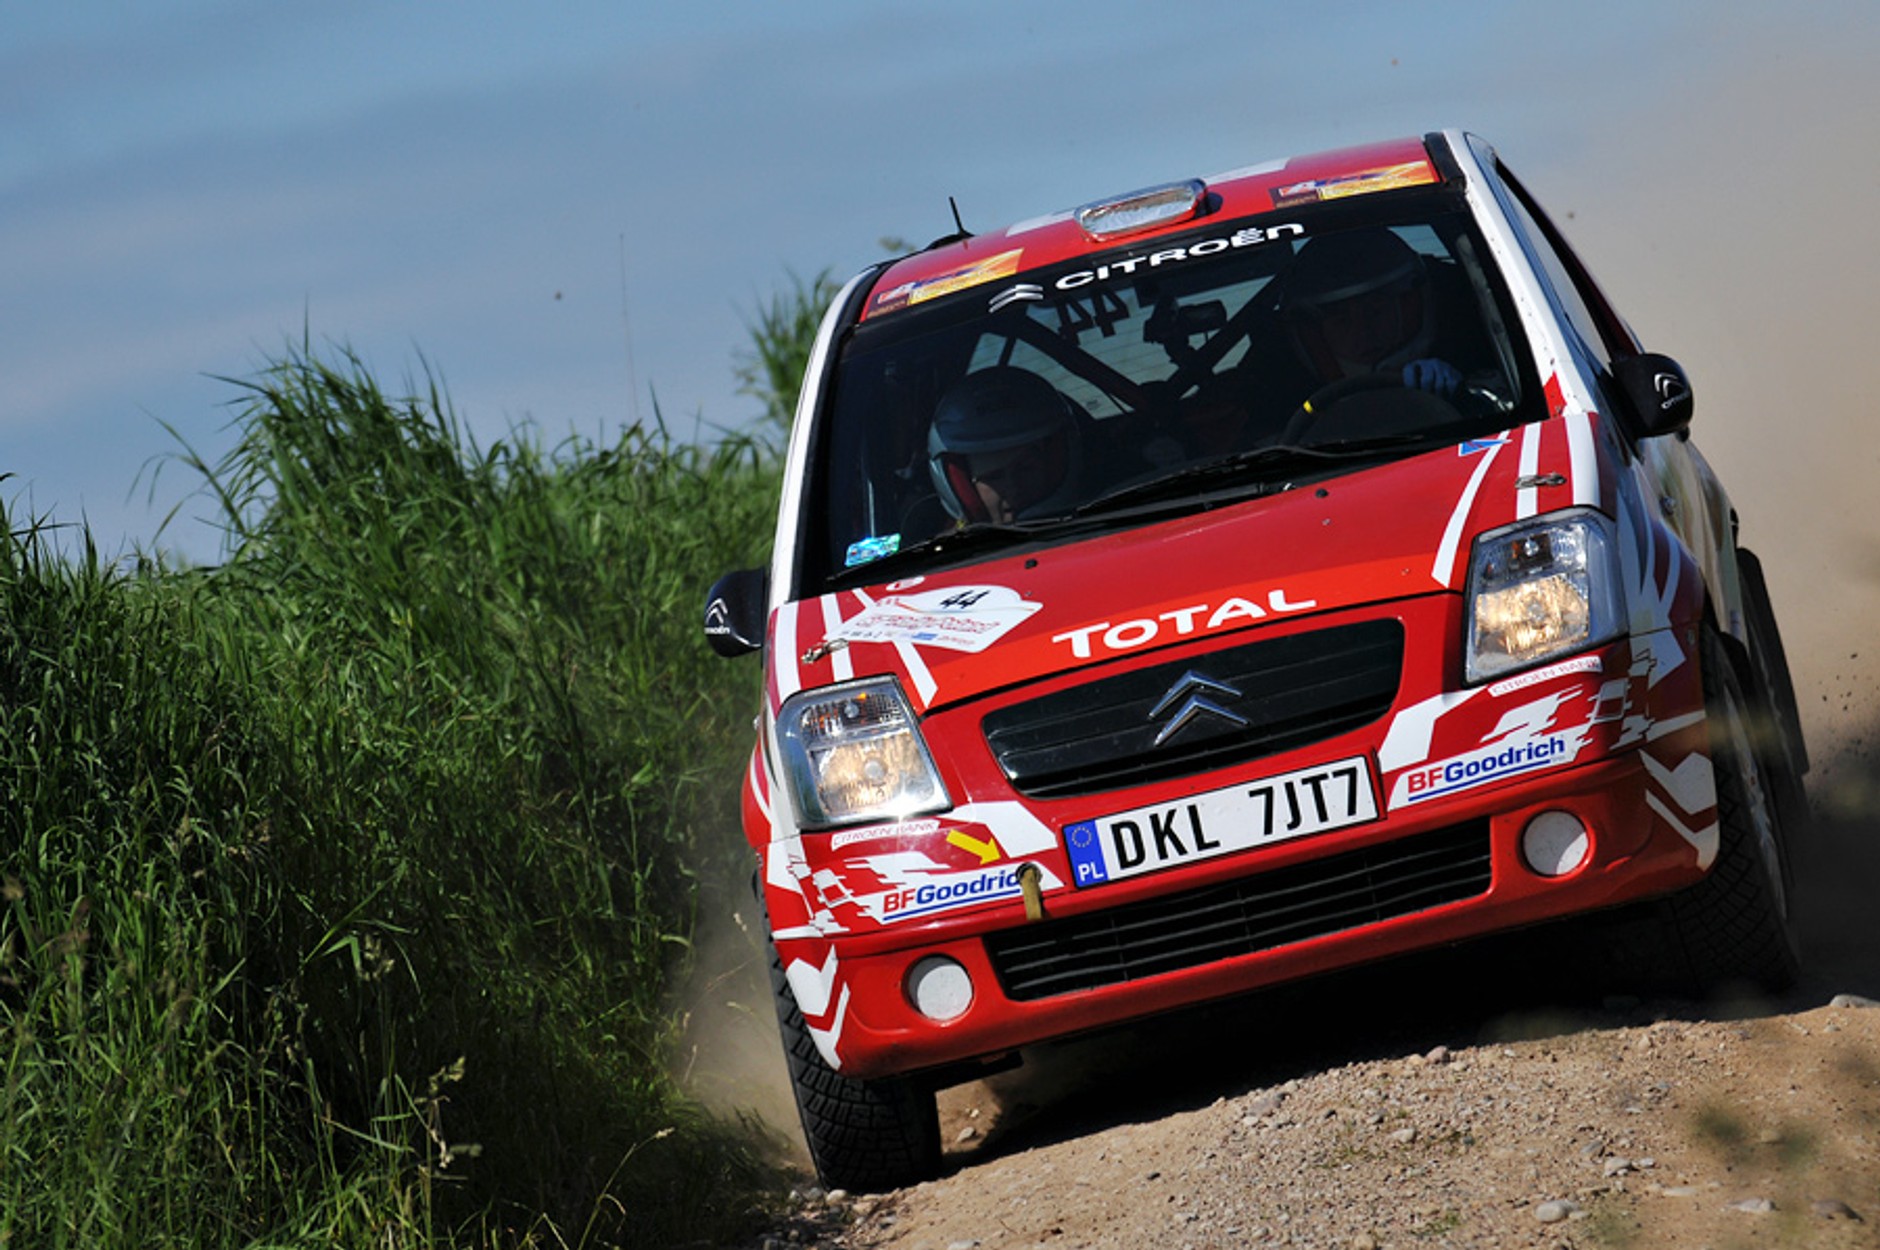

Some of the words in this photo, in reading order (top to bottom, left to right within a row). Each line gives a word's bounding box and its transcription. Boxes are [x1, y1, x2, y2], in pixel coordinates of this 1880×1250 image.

[939, 590, 992, 609] 44
[1052, 589, 1317, 658] TOTAL
[1407, 736, 1565, 794] BFGoodrich
[1110, 804, 1221, 870] DKL
[1248, 766, 1358, 836] 7JT7
[883, 869, 1022, 914] BFGoodric
[1077, 861, 1105, 882] PL
